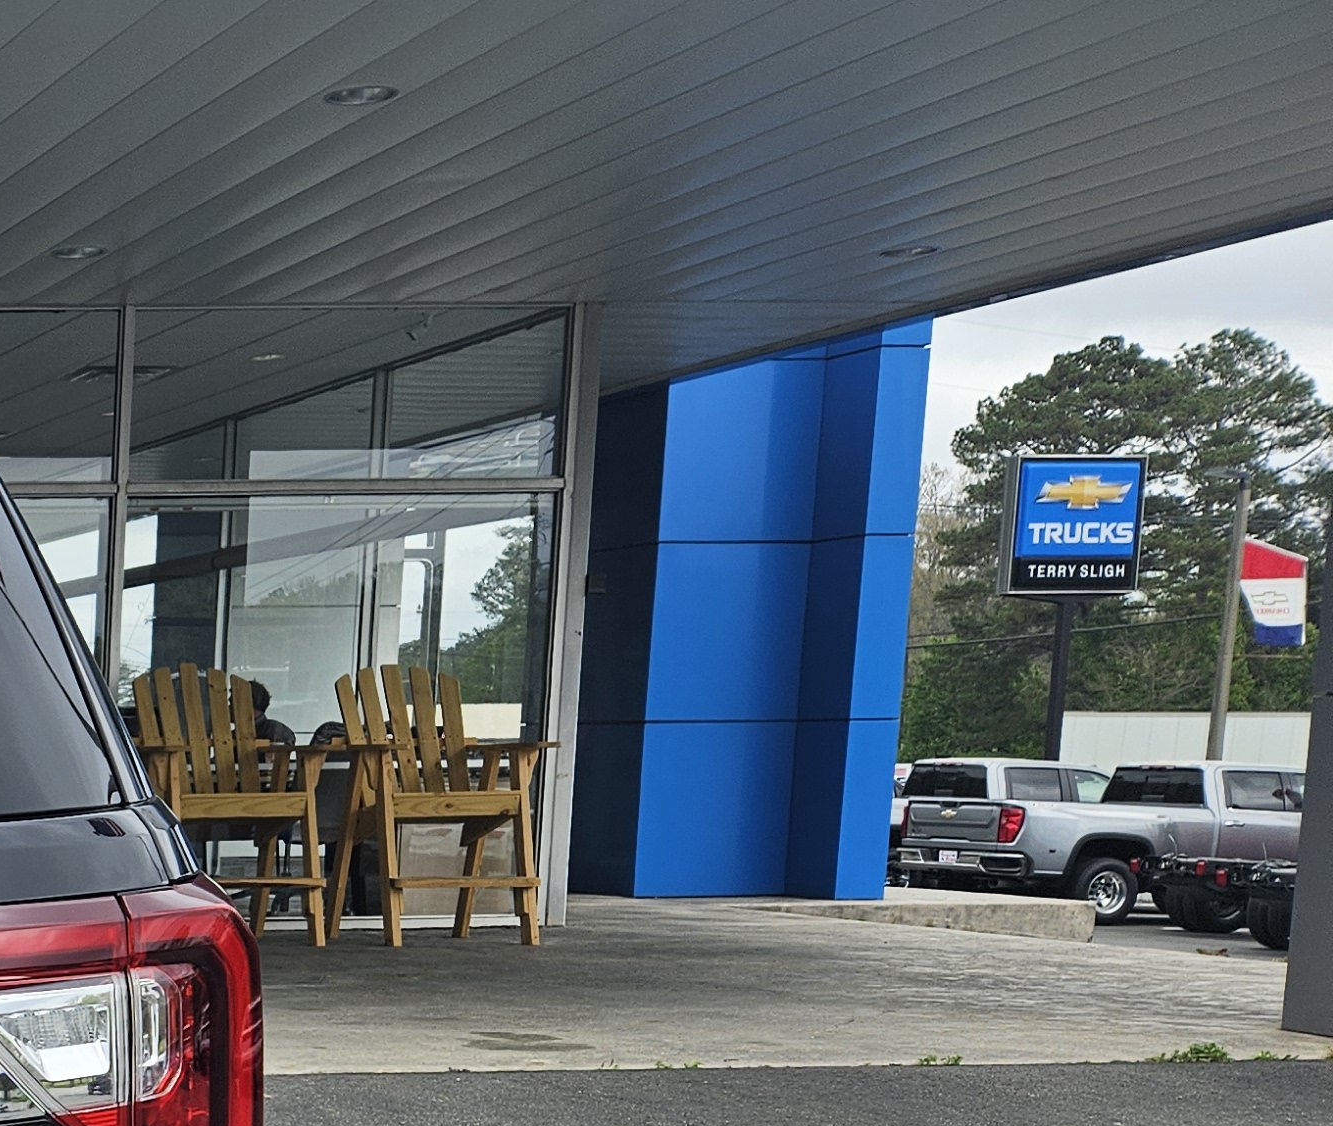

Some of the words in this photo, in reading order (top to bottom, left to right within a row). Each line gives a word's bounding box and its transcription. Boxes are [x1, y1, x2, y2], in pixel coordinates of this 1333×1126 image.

[1028, 521, 1133, 545] TRUCKS
[1028, 564, 1079, 578] TERRY
[1080, 564, 1125, 578] SLIGH
